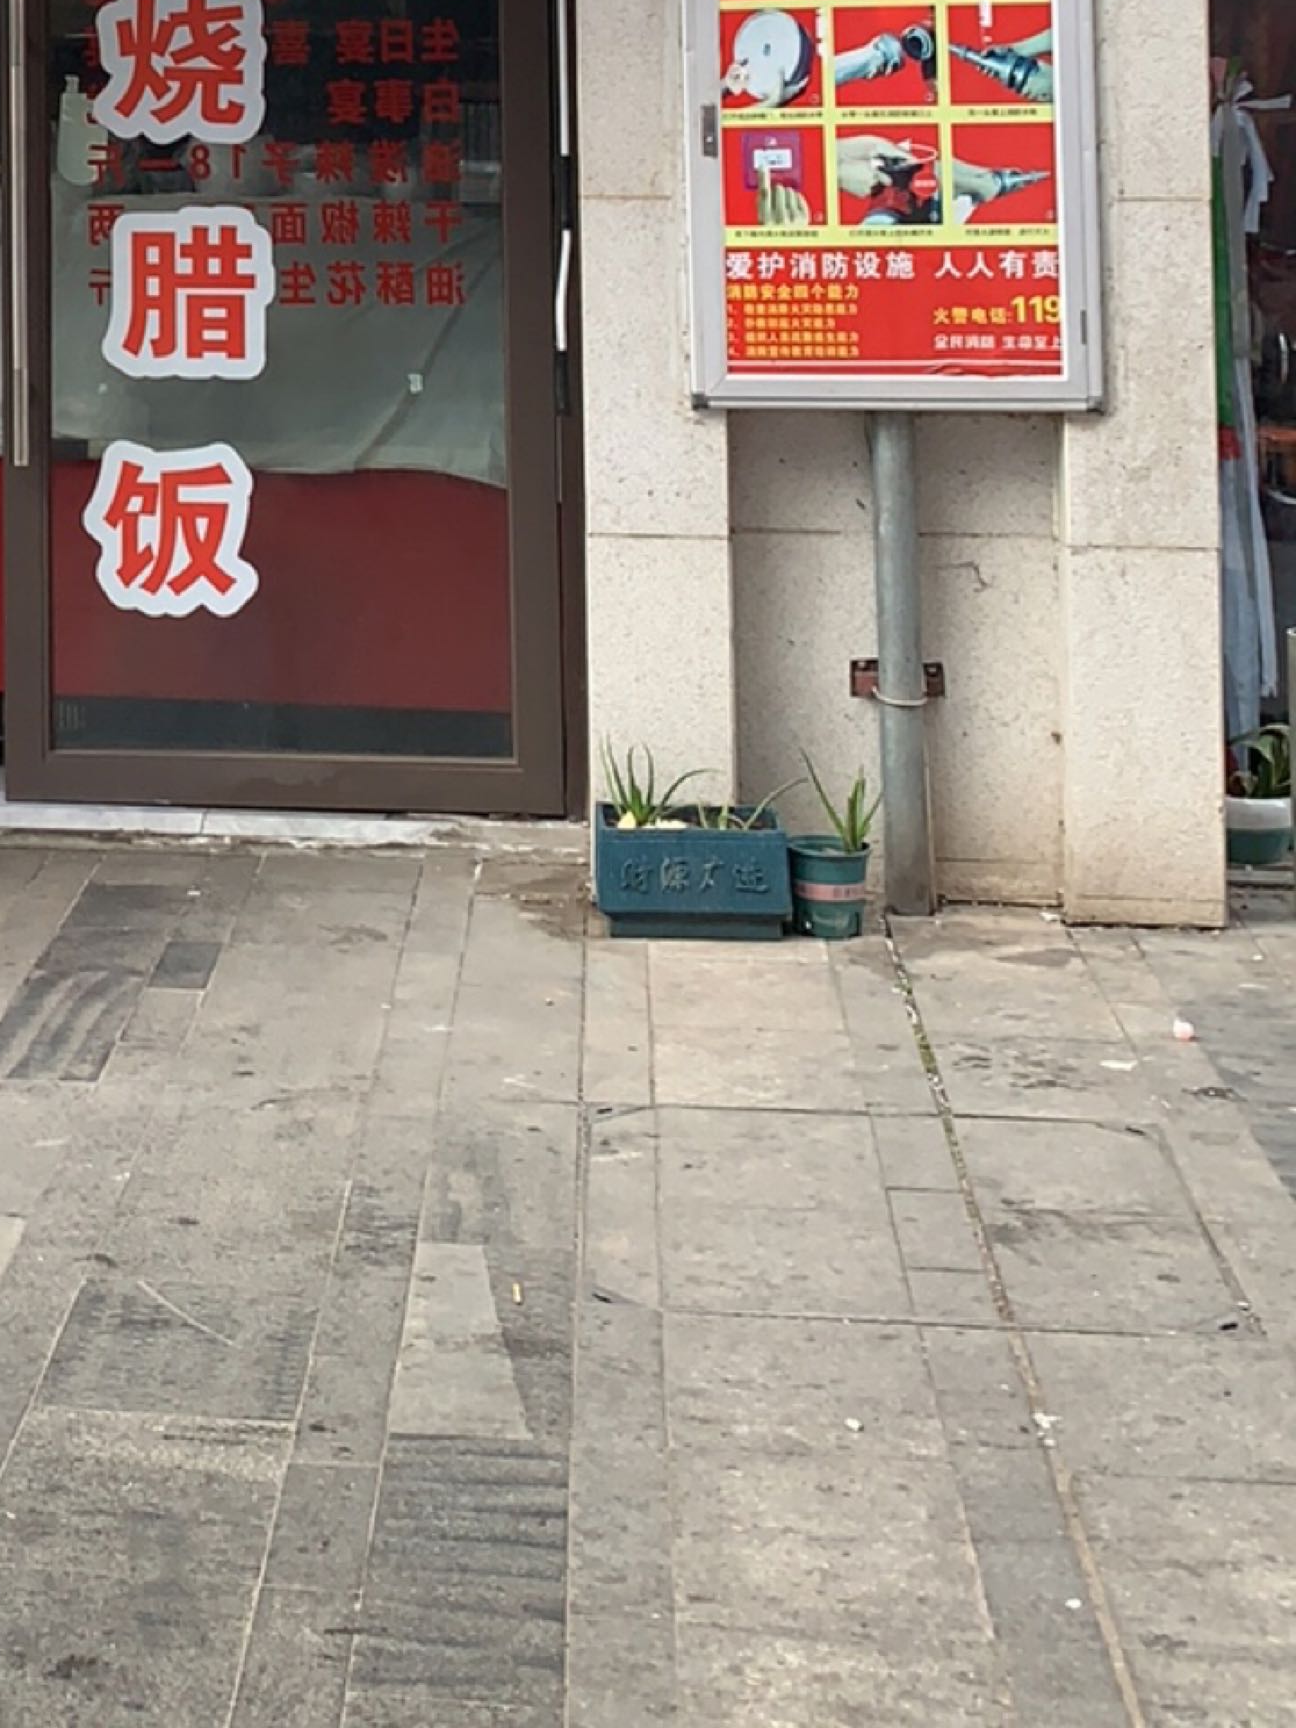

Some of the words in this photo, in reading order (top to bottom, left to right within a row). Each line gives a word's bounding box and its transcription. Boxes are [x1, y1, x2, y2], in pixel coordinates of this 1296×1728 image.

[726, 250, 917, 280] 爱护消防设施
[934, 250, 1059, 280] 人人有责
